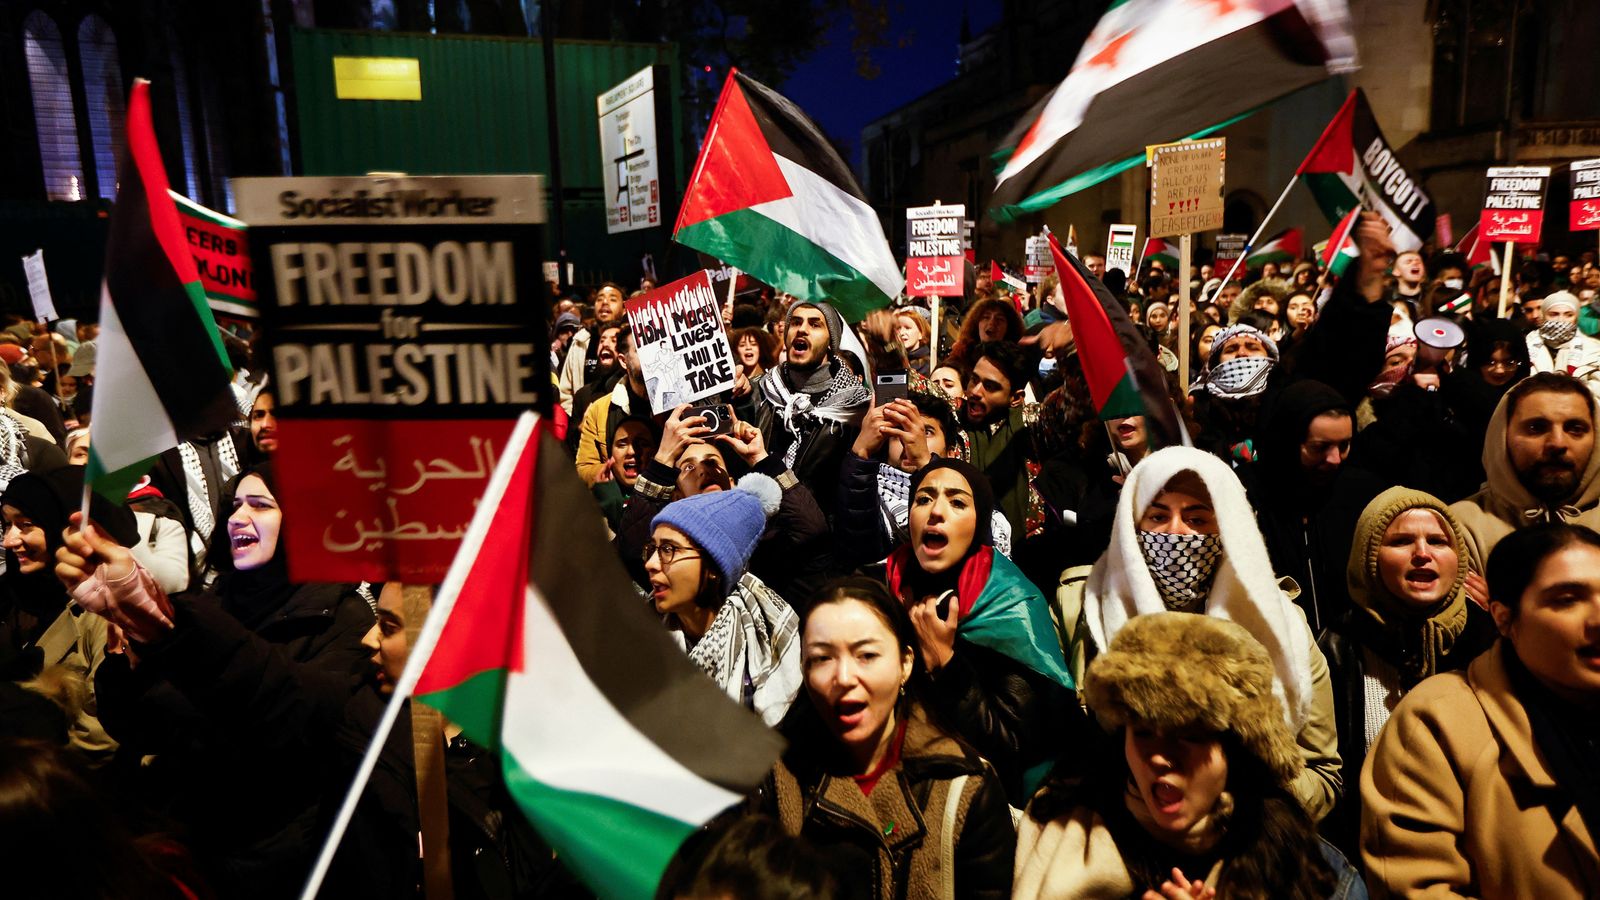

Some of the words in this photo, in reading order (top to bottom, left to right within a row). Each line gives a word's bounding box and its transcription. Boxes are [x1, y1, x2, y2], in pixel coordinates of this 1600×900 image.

[1162, 177, 1179, 188] ALL
[1182, 175, 1193, 186] OF
[1196, 174, 1207, 184] US
[1363, 137, 1429, 220] BOYCOTT
[1490, 178, 1542, 191] FREEDOM
[1168, 188, 1184, 200] ARE
[1187, 186, 1207, 197] FREE
[1485, 195, 1541, 208] PALESTINE
[911, 218, 958, 236] FREEDOM
[186, 226, 237, 256] EERS
[909, 240, 960, 257] PALESTINE
[1109, 248, 1131, 260] FREE
[269, 241, 517, 307] FREEDOM
[380, 308, 422, 339] for
[273, 343, 537, 406] PALESTINE
[684, 359, 733, 394] TAKE
[332, 434, 497, 494] الحرية
